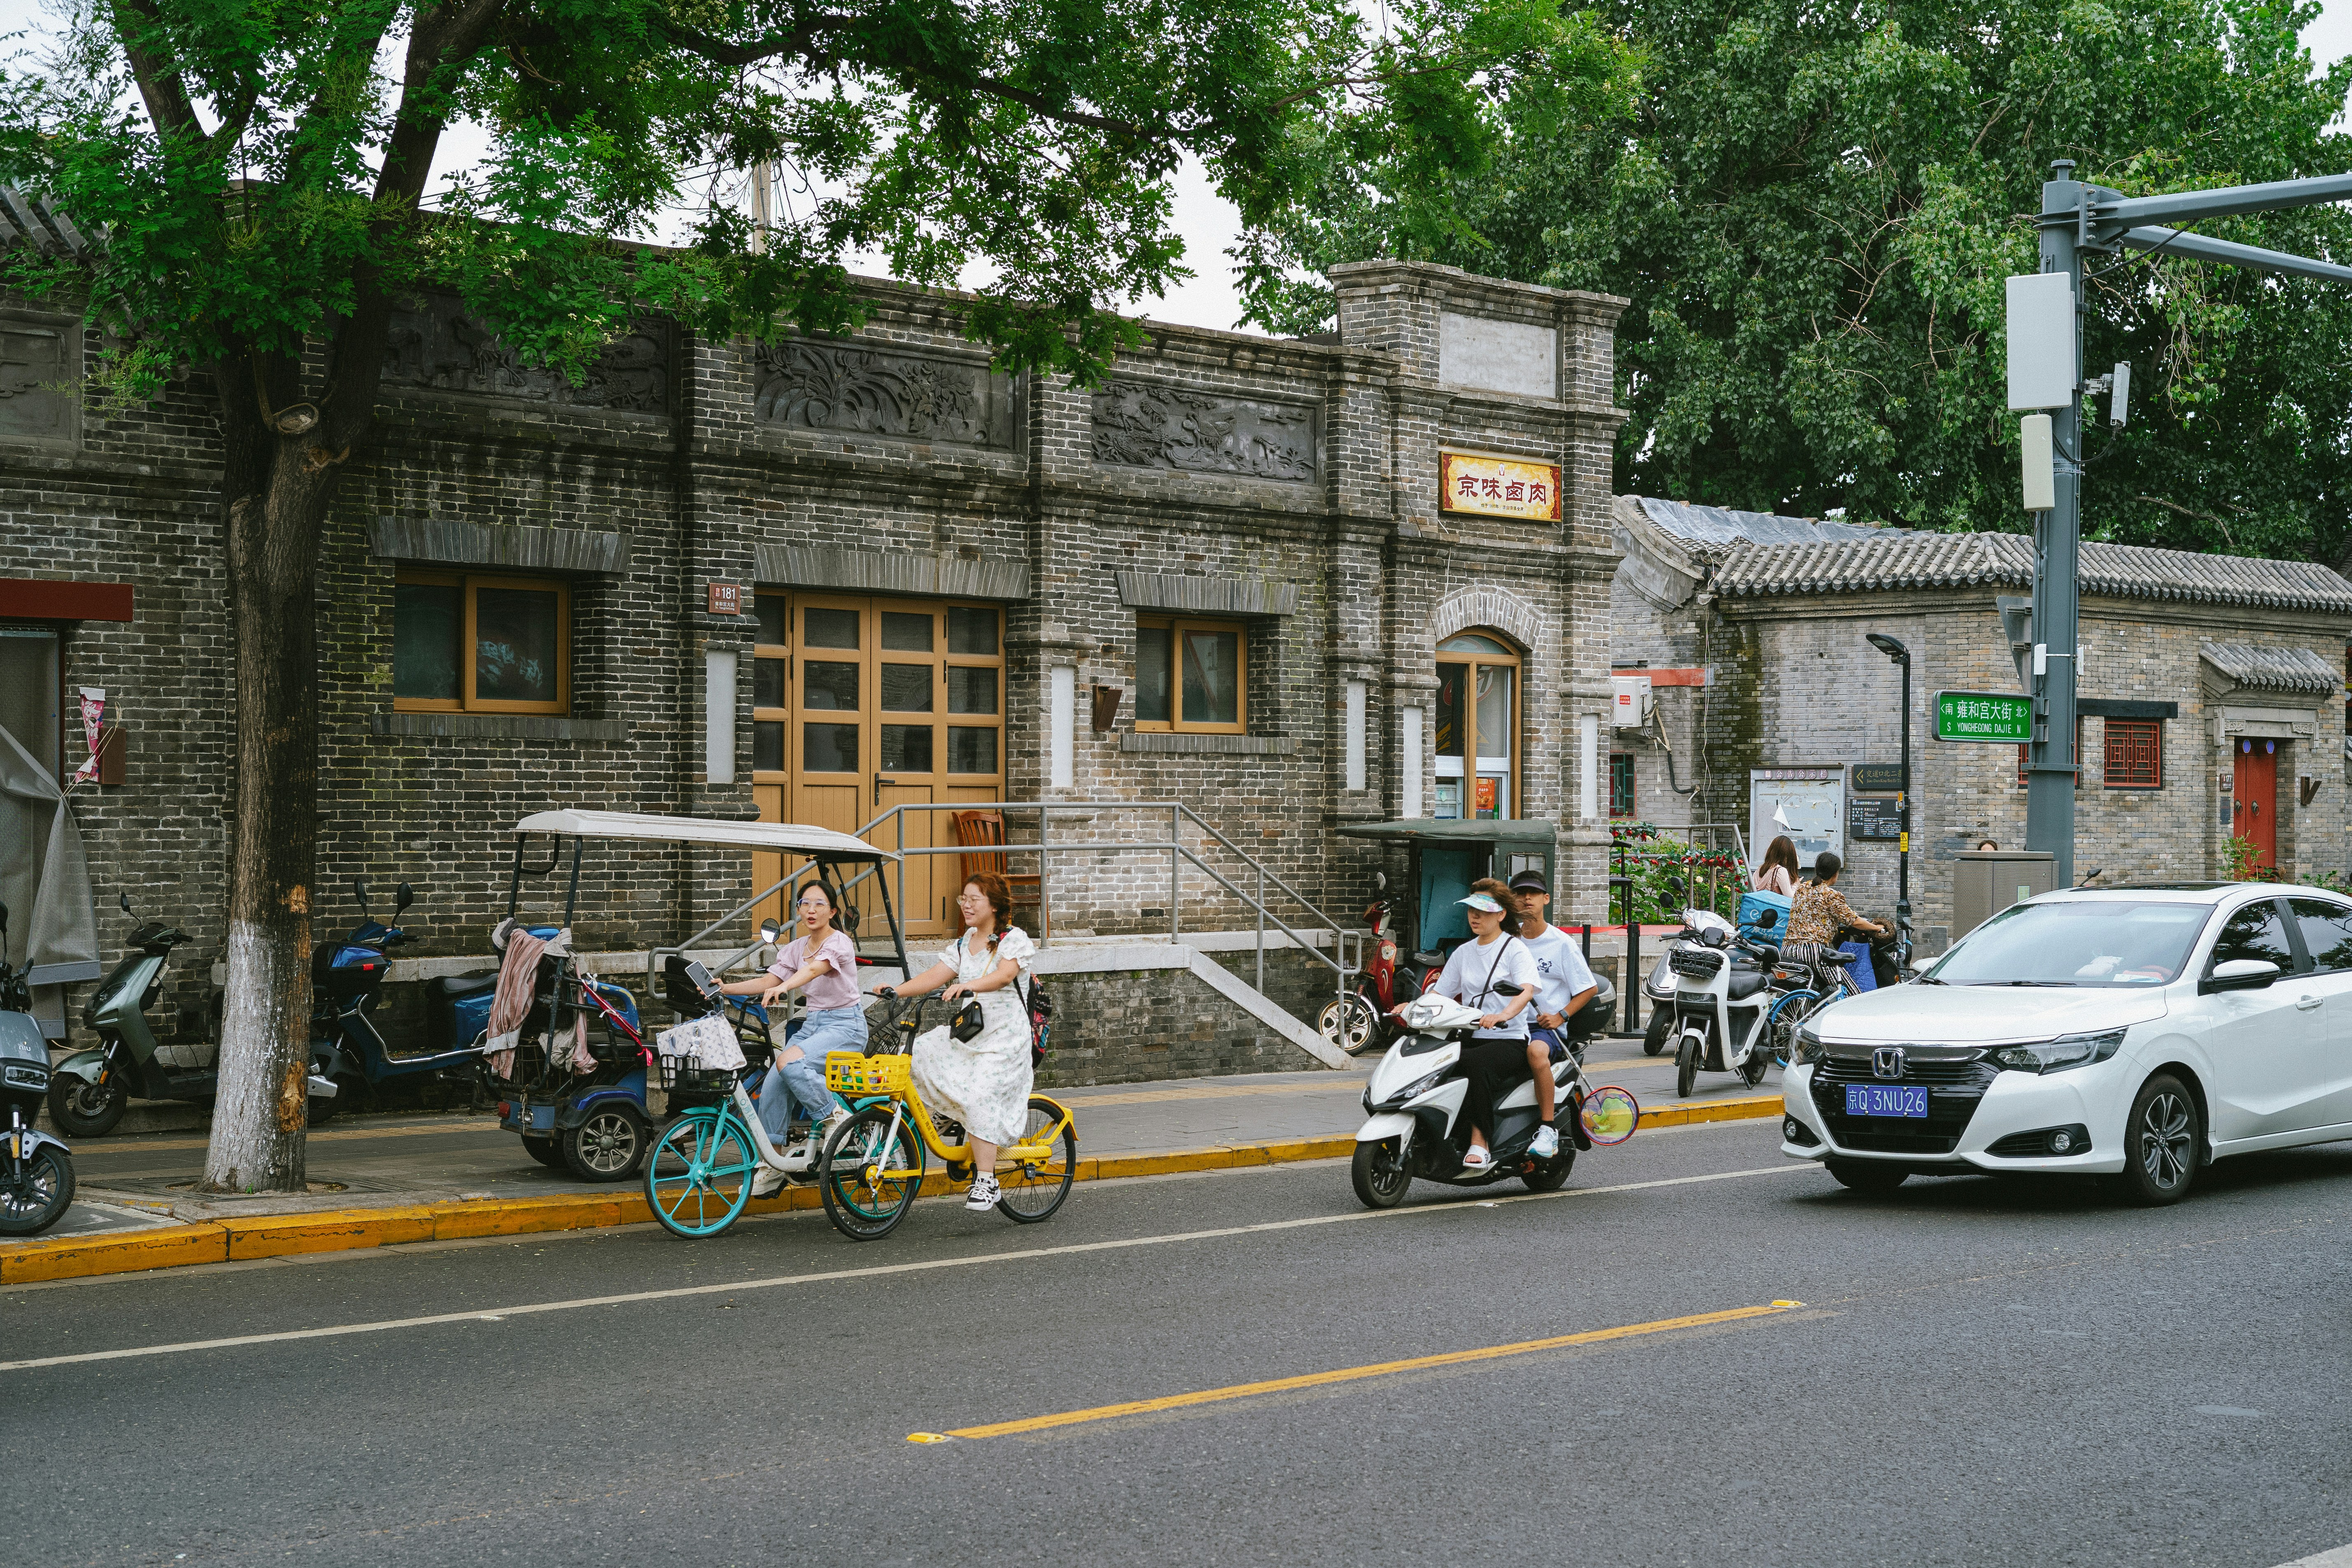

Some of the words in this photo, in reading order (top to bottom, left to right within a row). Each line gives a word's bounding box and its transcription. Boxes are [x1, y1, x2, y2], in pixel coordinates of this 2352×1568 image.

[1457, 474, 1546, 505] 京味卤肉
[722, 587, 735, 599] 181
[1945, 703, 1953, 715] 南
[1957, 700, 2012, 720] 雍和宫大街
[2016, 706, 2023, 718] 北
[1947, 722, 1951, 732] S
[1957, 722, 1992, 733] YONGHEGONG
[1995, 724, 2012, 734] DAJIE
[2017, 725, 2021, 734] N
[1776, 769, 1827, 778] 公告公示栏
[1866, 769, 1902, 778] 交道口北二条
[19, 1041, 31, 1051] niu
[1848, 1089, 1924, 1112] 京Q·3NU26
